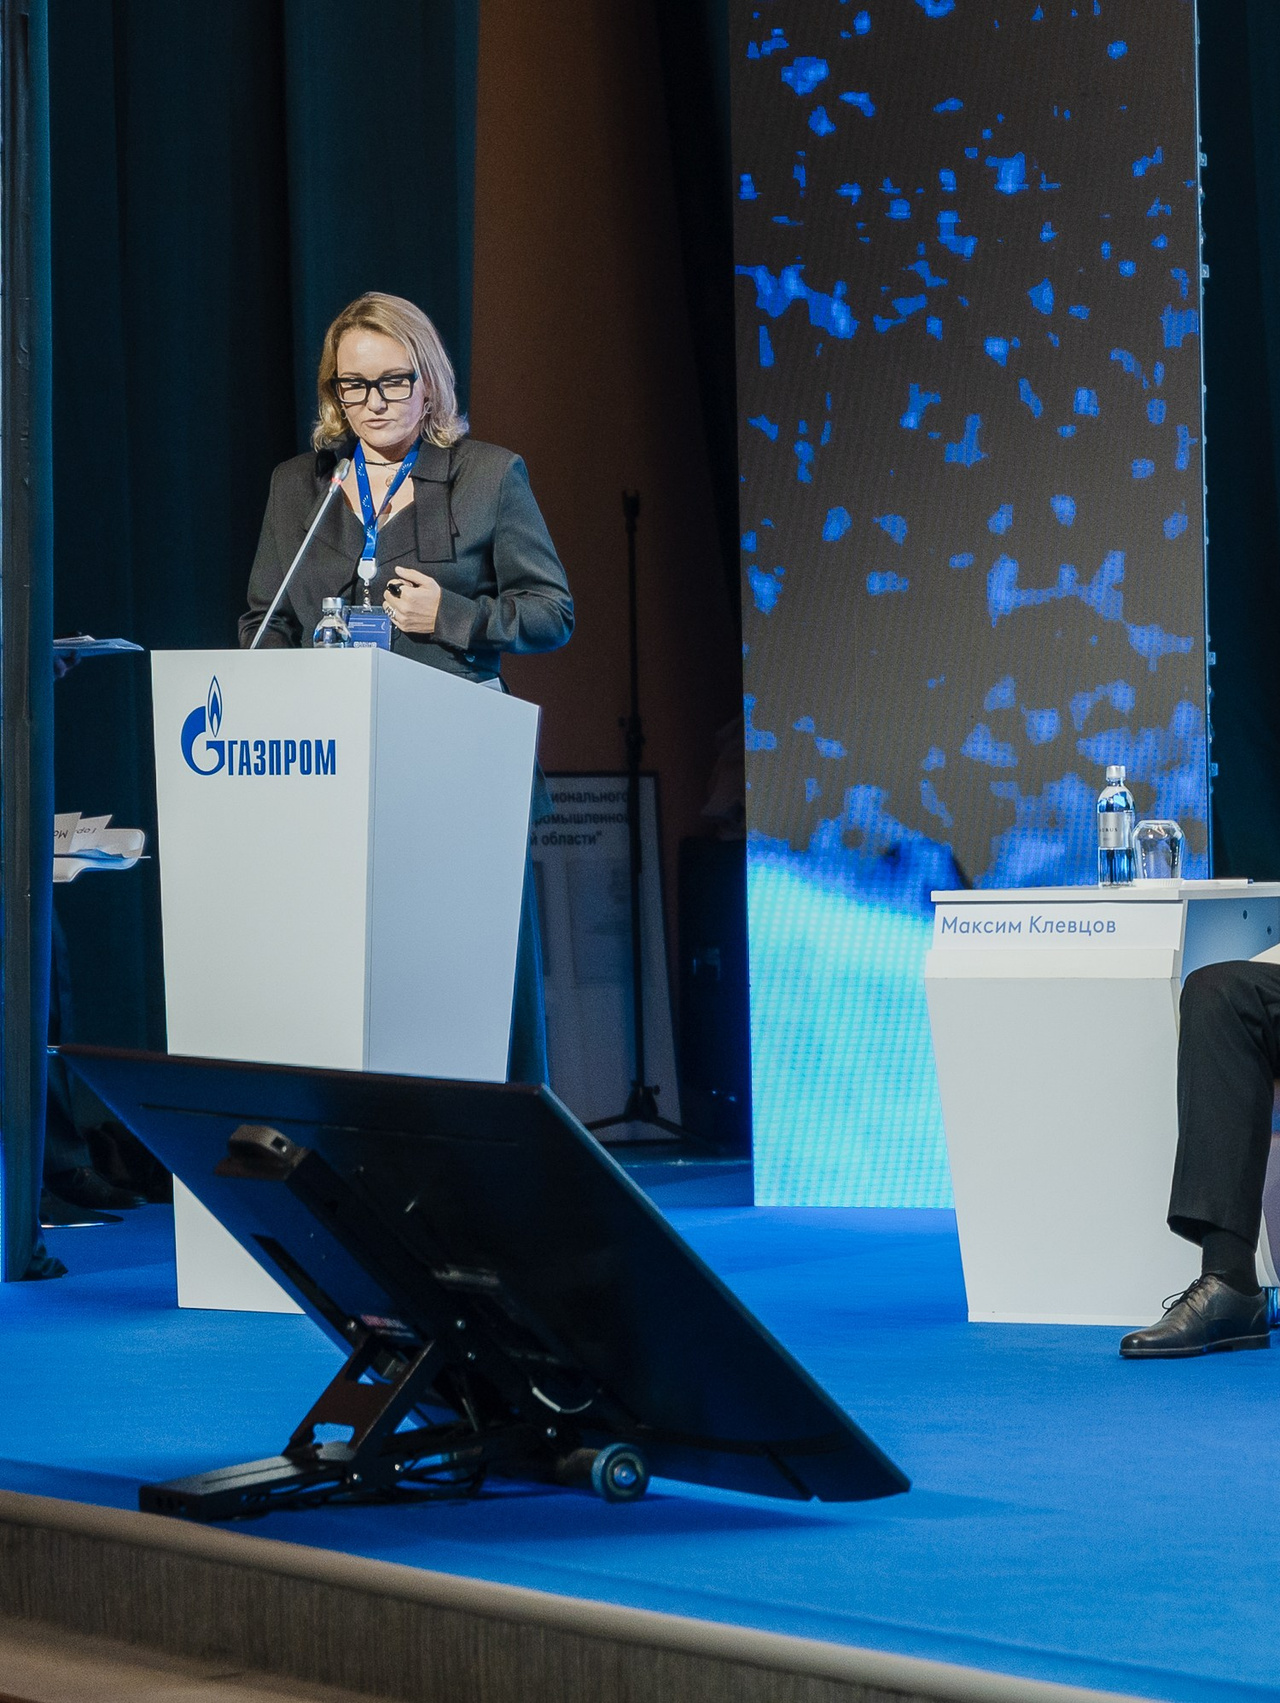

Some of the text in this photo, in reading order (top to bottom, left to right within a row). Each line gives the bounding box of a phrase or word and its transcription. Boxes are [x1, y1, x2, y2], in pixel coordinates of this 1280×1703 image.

[228, 739, 336, 776] ГАЗПРОМ
[941, 915, 1117, 936] Максим Клевцов
